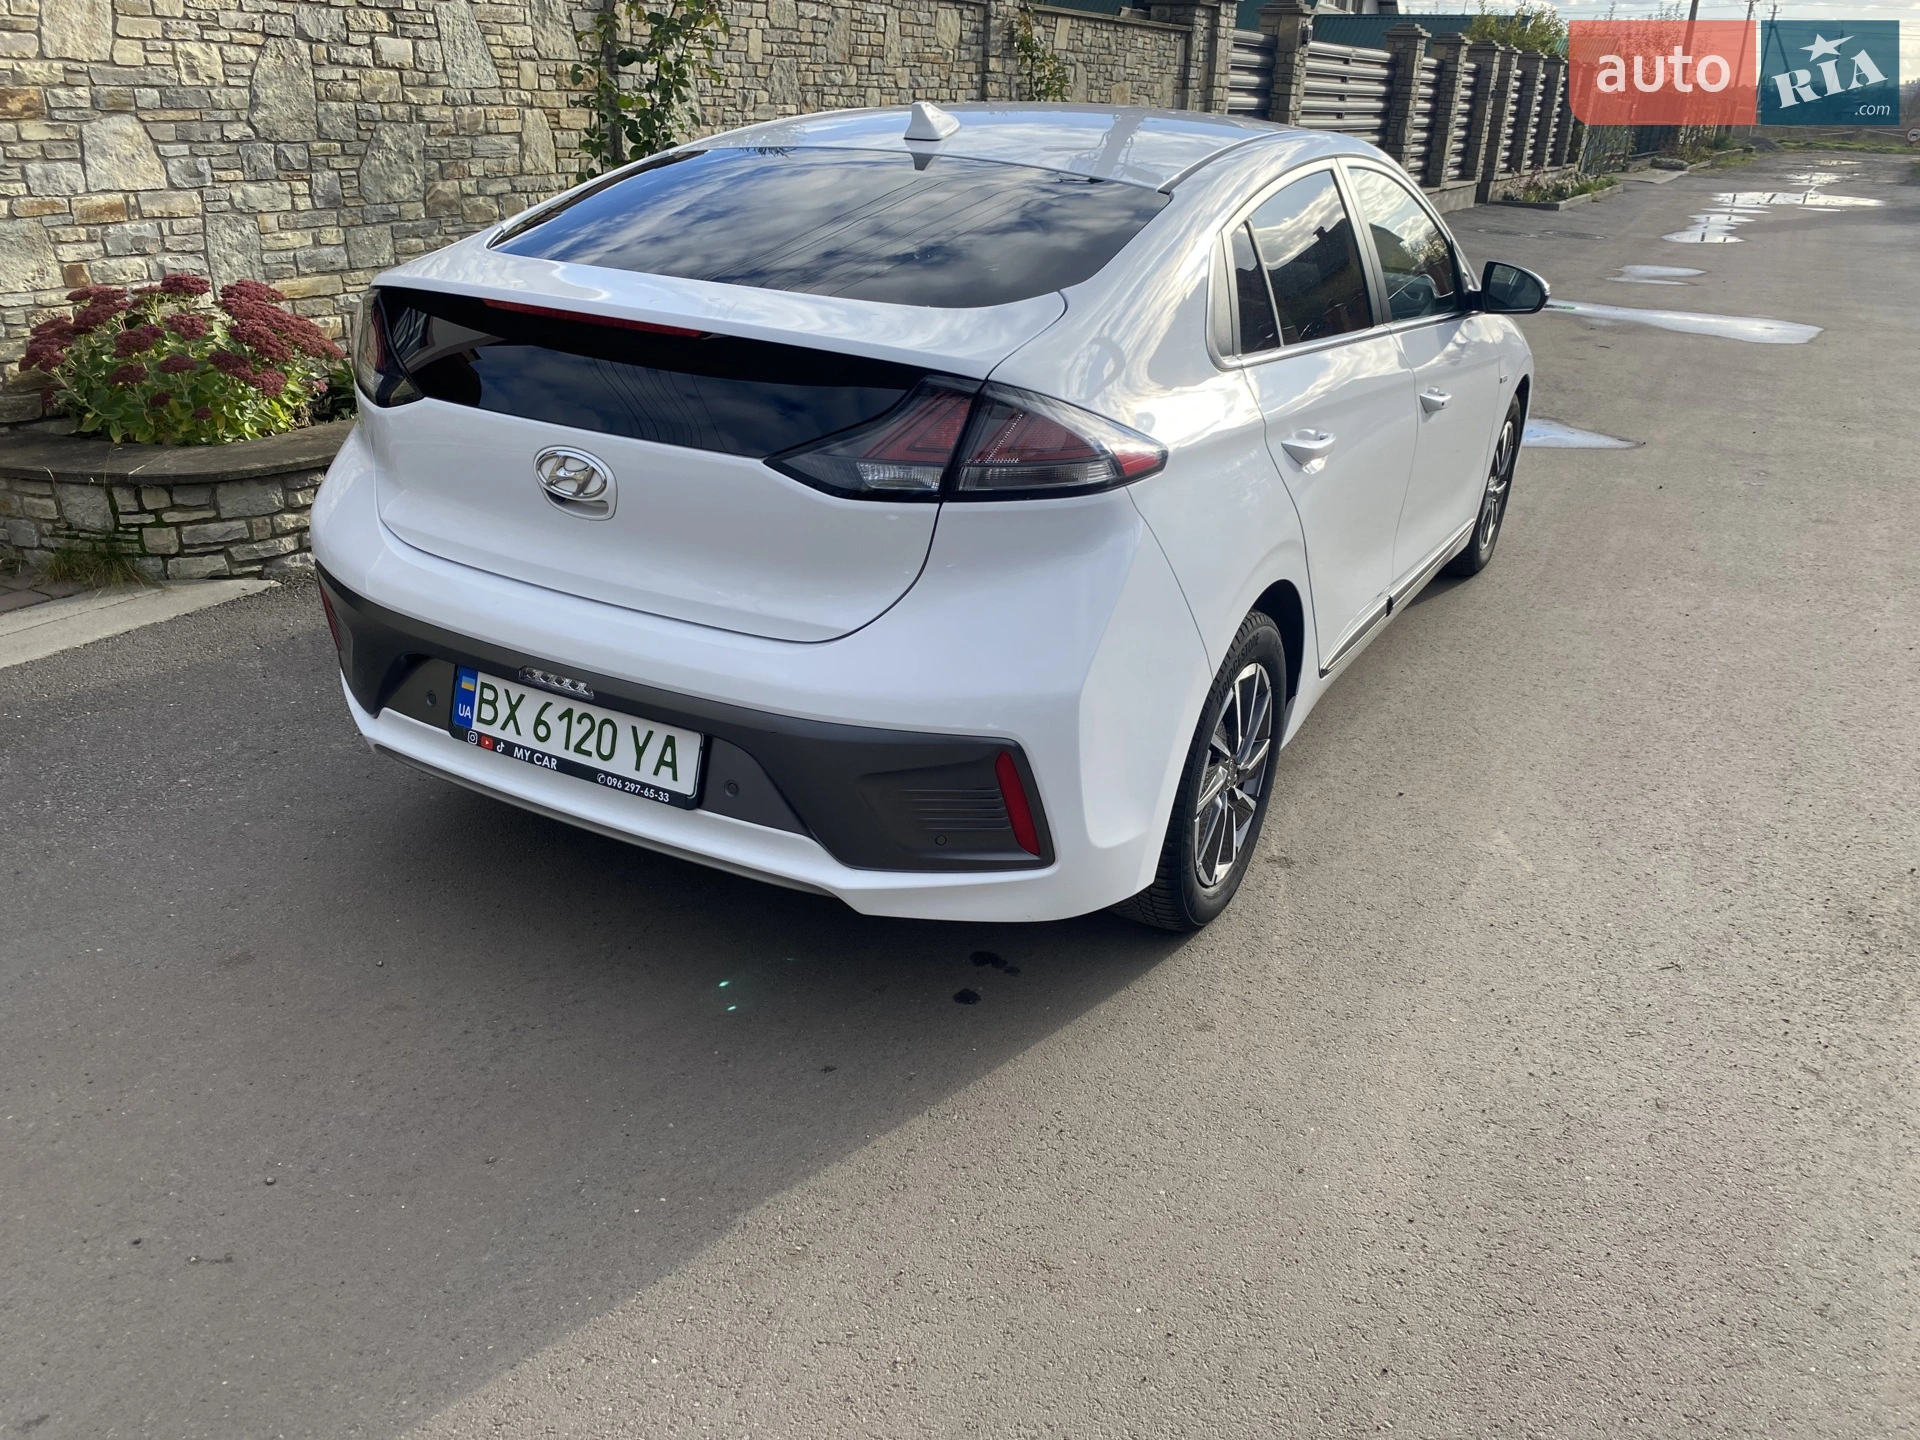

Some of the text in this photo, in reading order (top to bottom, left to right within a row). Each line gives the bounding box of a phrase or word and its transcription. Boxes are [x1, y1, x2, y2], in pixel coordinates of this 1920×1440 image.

[1216, 632, 1260, 708] BRIDGESTONE
[458, 703, 472, 719] UA
[476, 681, 678, 781] BX 6120 YA
[513, 749, 558, 770] MY CAR
[606, 775, 670, 803] 096 297-65-33
